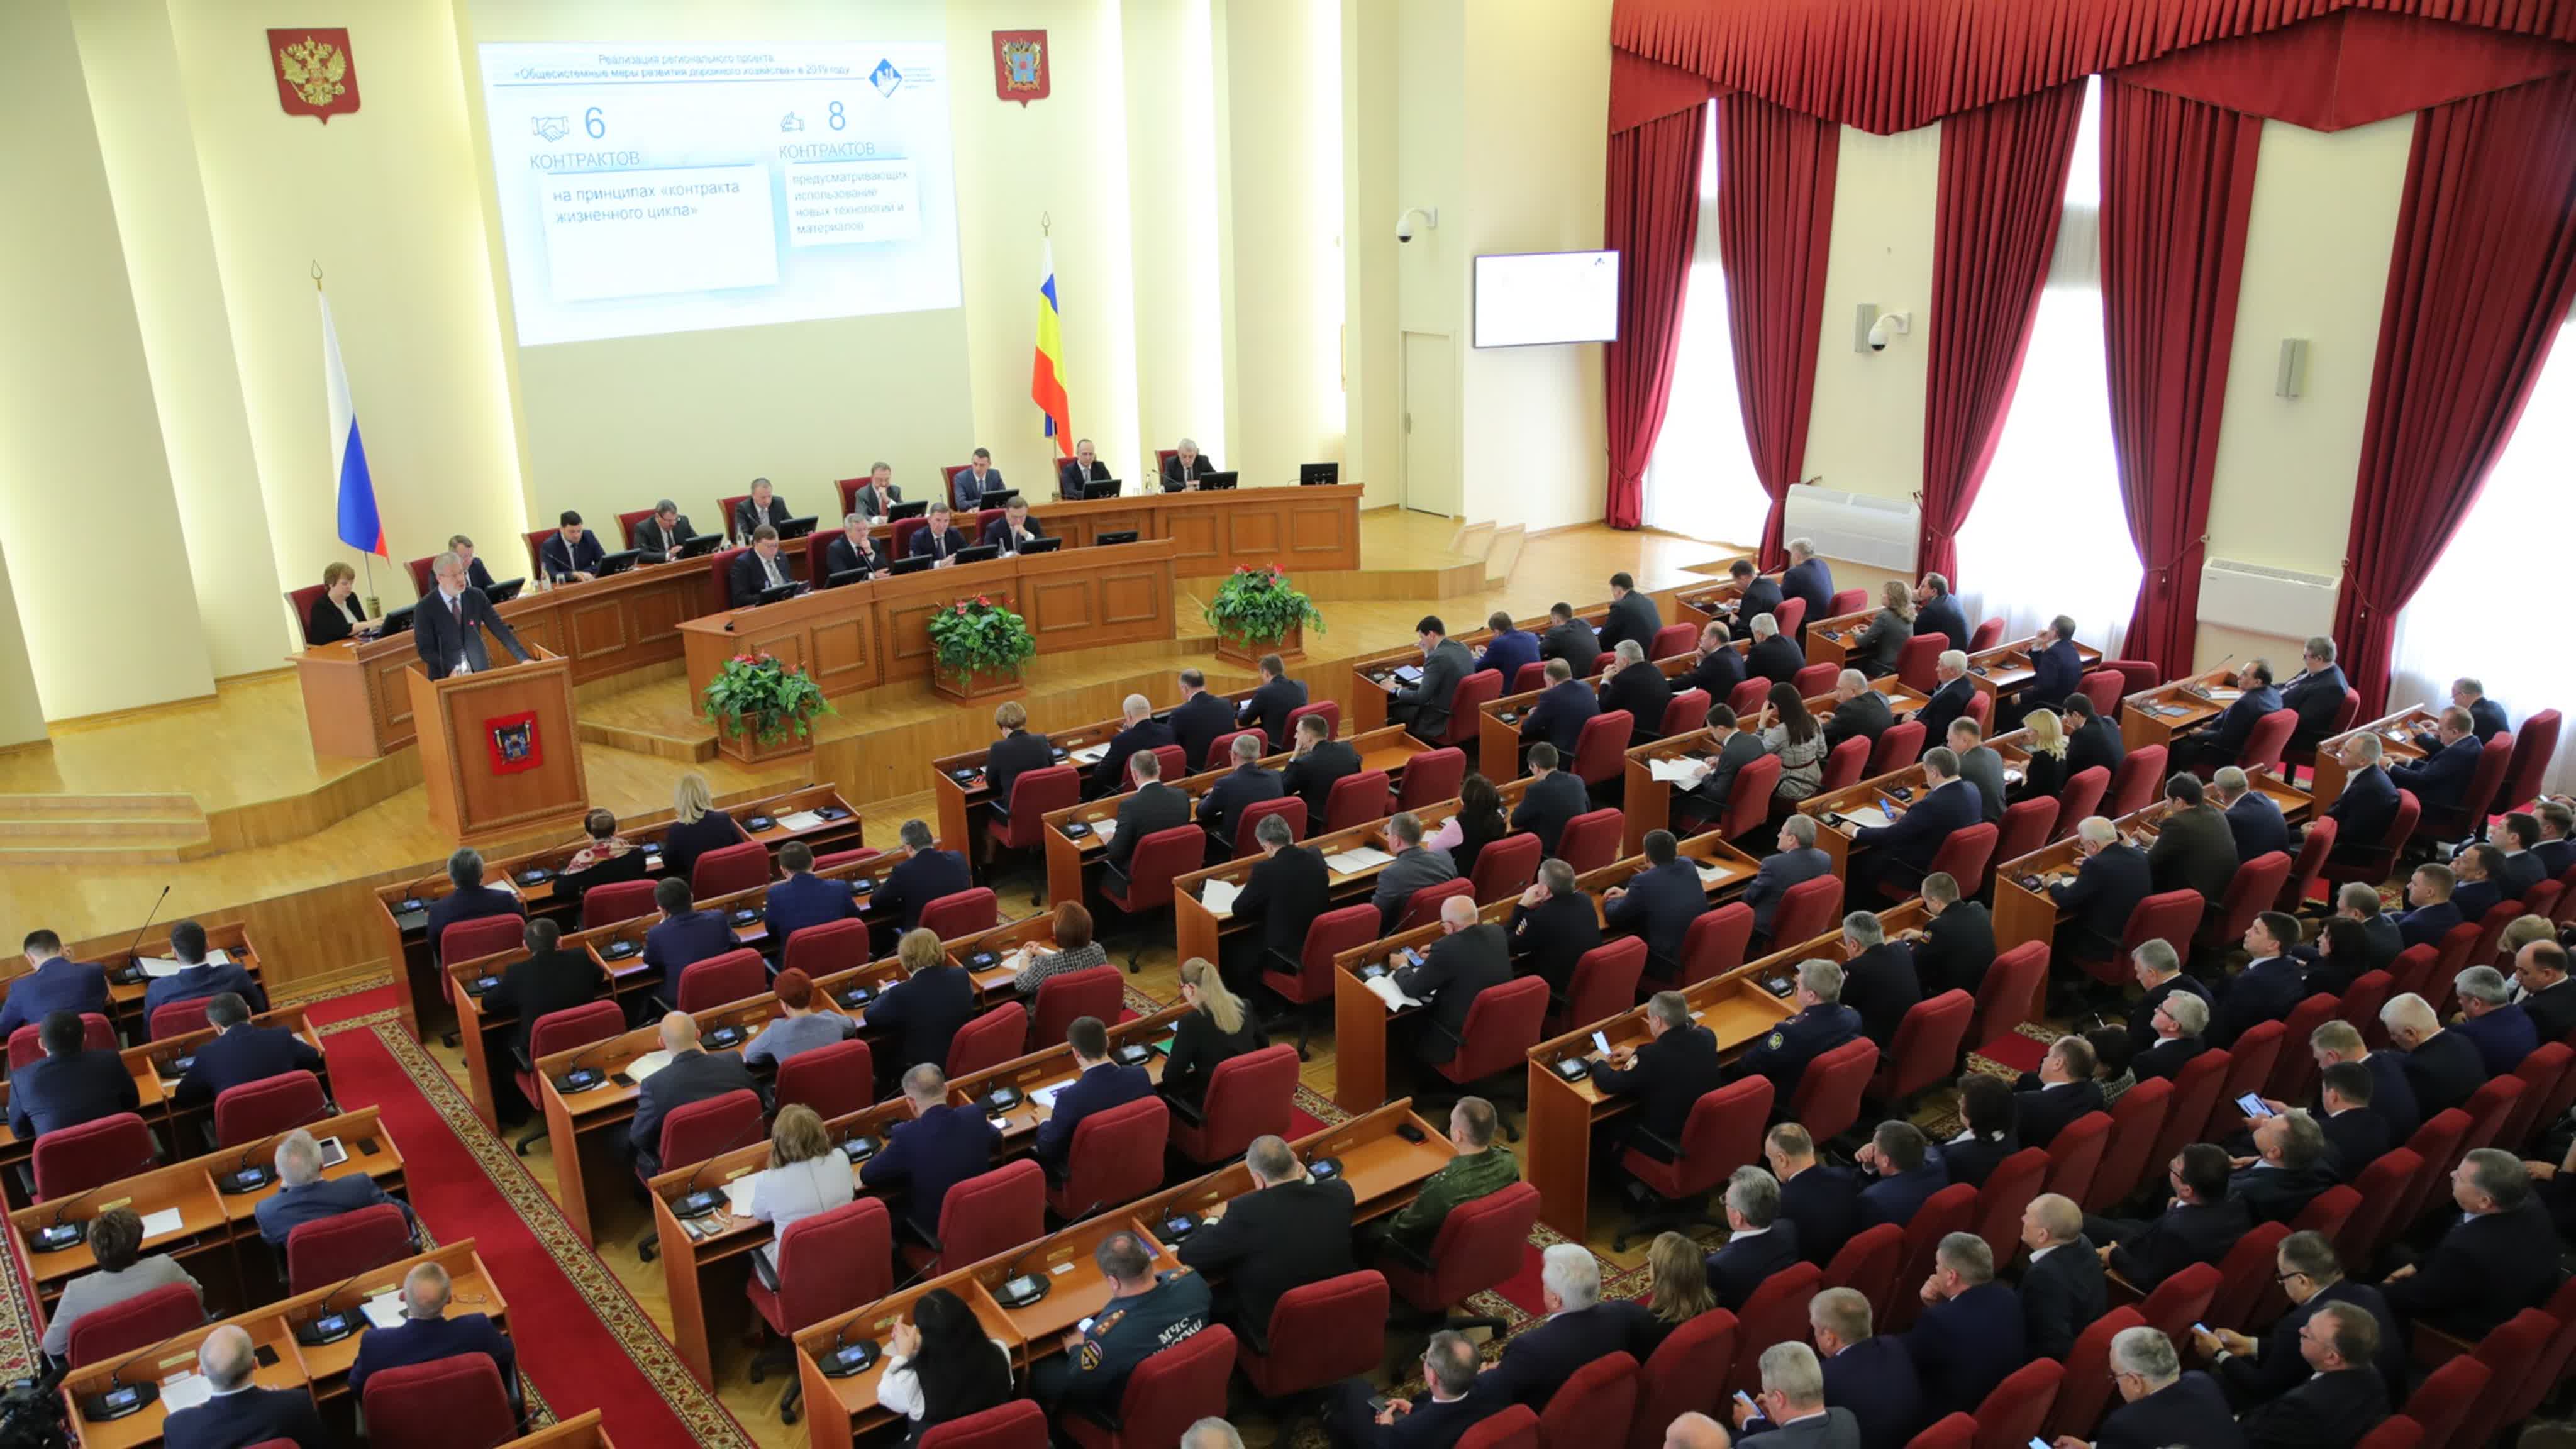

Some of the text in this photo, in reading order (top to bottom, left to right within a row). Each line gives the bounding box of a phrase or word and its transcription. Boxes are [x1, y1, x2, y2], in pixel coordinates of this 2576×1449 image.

[806, 65, 828, 75] 2019
[586, 106, 606, 140] 6
[829, 100, 846, 131] 8
[530, 150, 640, 169] КОНТРАКТОВ
[779, 142, 876, 159] КОНТРАКТОВ
[792, 171, 909, 186] предусматривающих
[553, 182, 740, 204] на принципах «контракта
[794, 189, 878, 202] использование
[556, 204, 698, 223] жизненного цикла»
[796, 207, 830, 217] новых
[897, 203, 904, 213] и
[797, 221, 864, 234] материалов
[1158, 1316, 1189, 1345] МЧС
